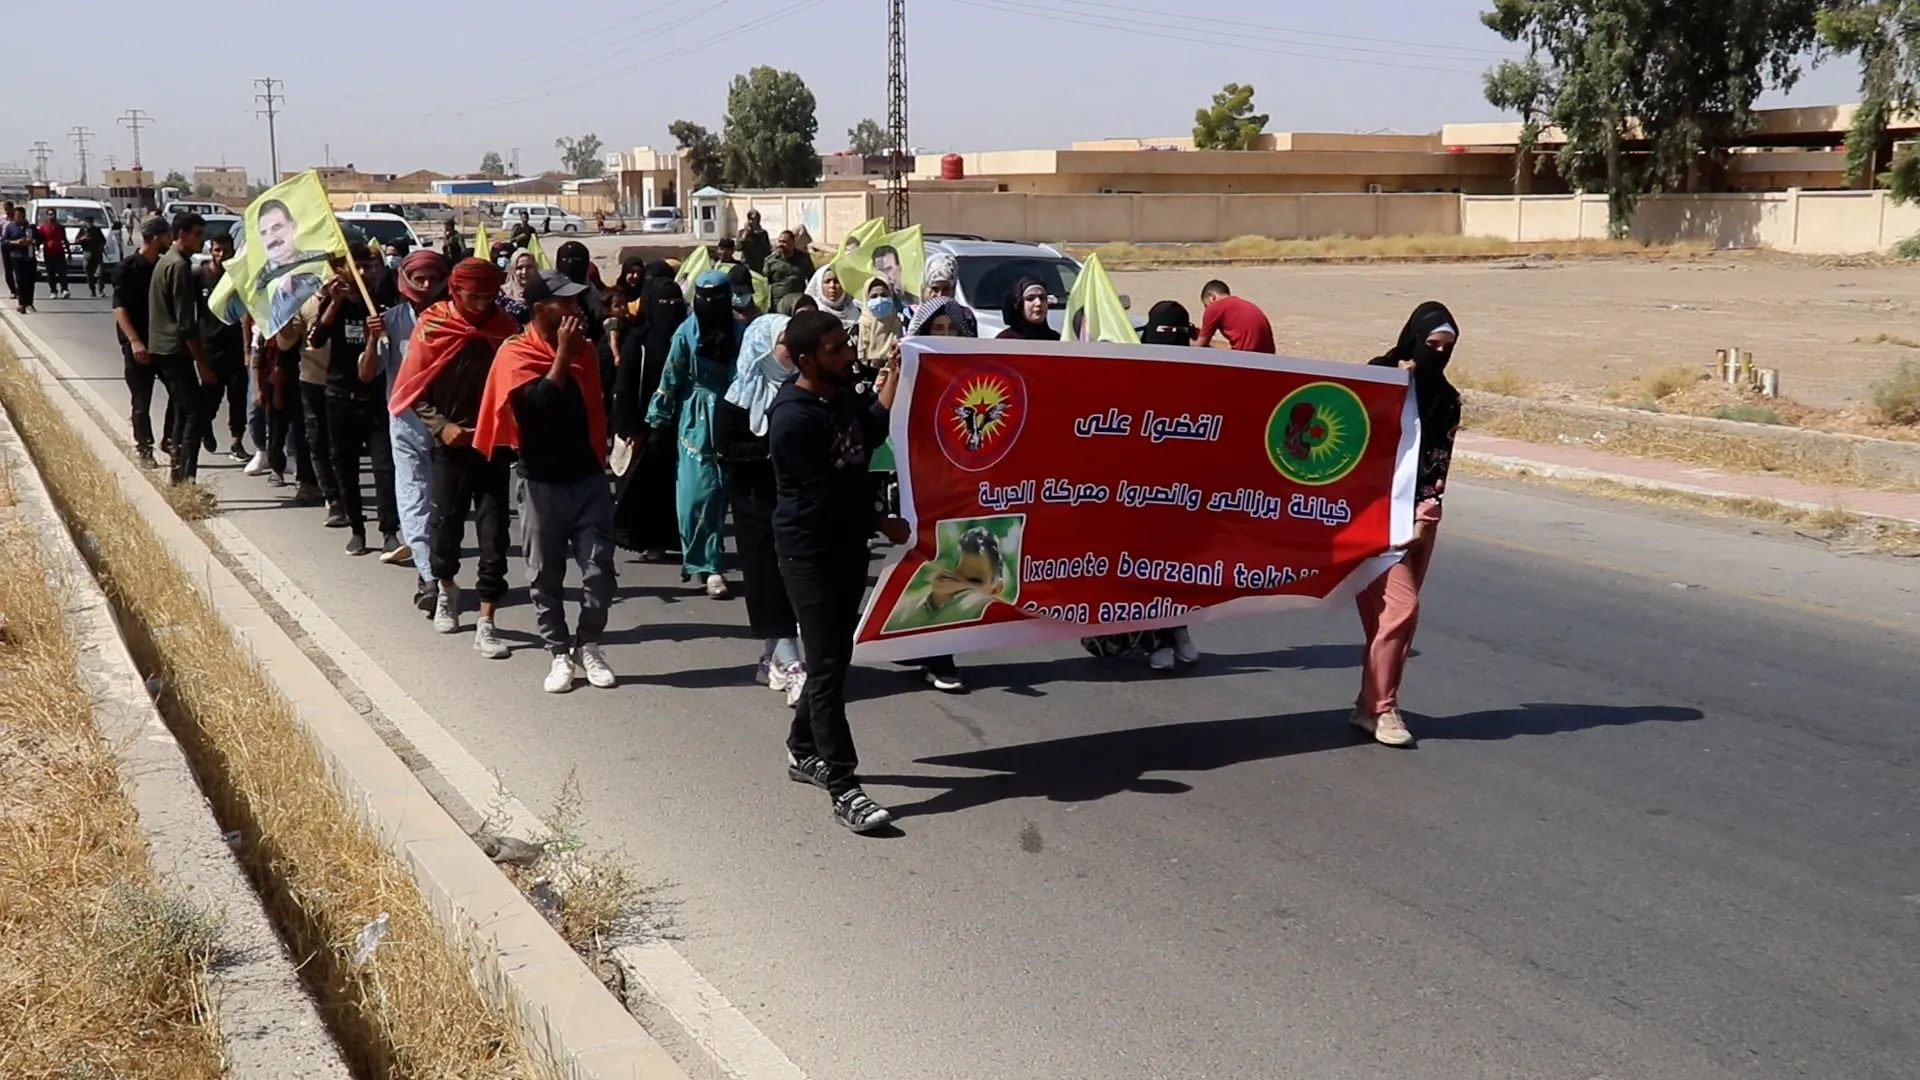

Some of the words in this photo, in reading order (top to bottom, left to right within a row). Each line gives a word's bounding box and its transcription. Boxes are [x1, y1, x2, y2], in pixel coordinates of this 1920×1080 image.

[1074, 408, 1133, 437] على
[1140, 410, 1223, 443] اقضوا
[978, 479, 1036, 511] الحرية
[1041, 478, 1110, 507] معركة
[1116, 480, 1202, 511] وانصروا
[1288, 493, 1351, 526] خيانة
[1117, 551, 1224, 586] berzani
